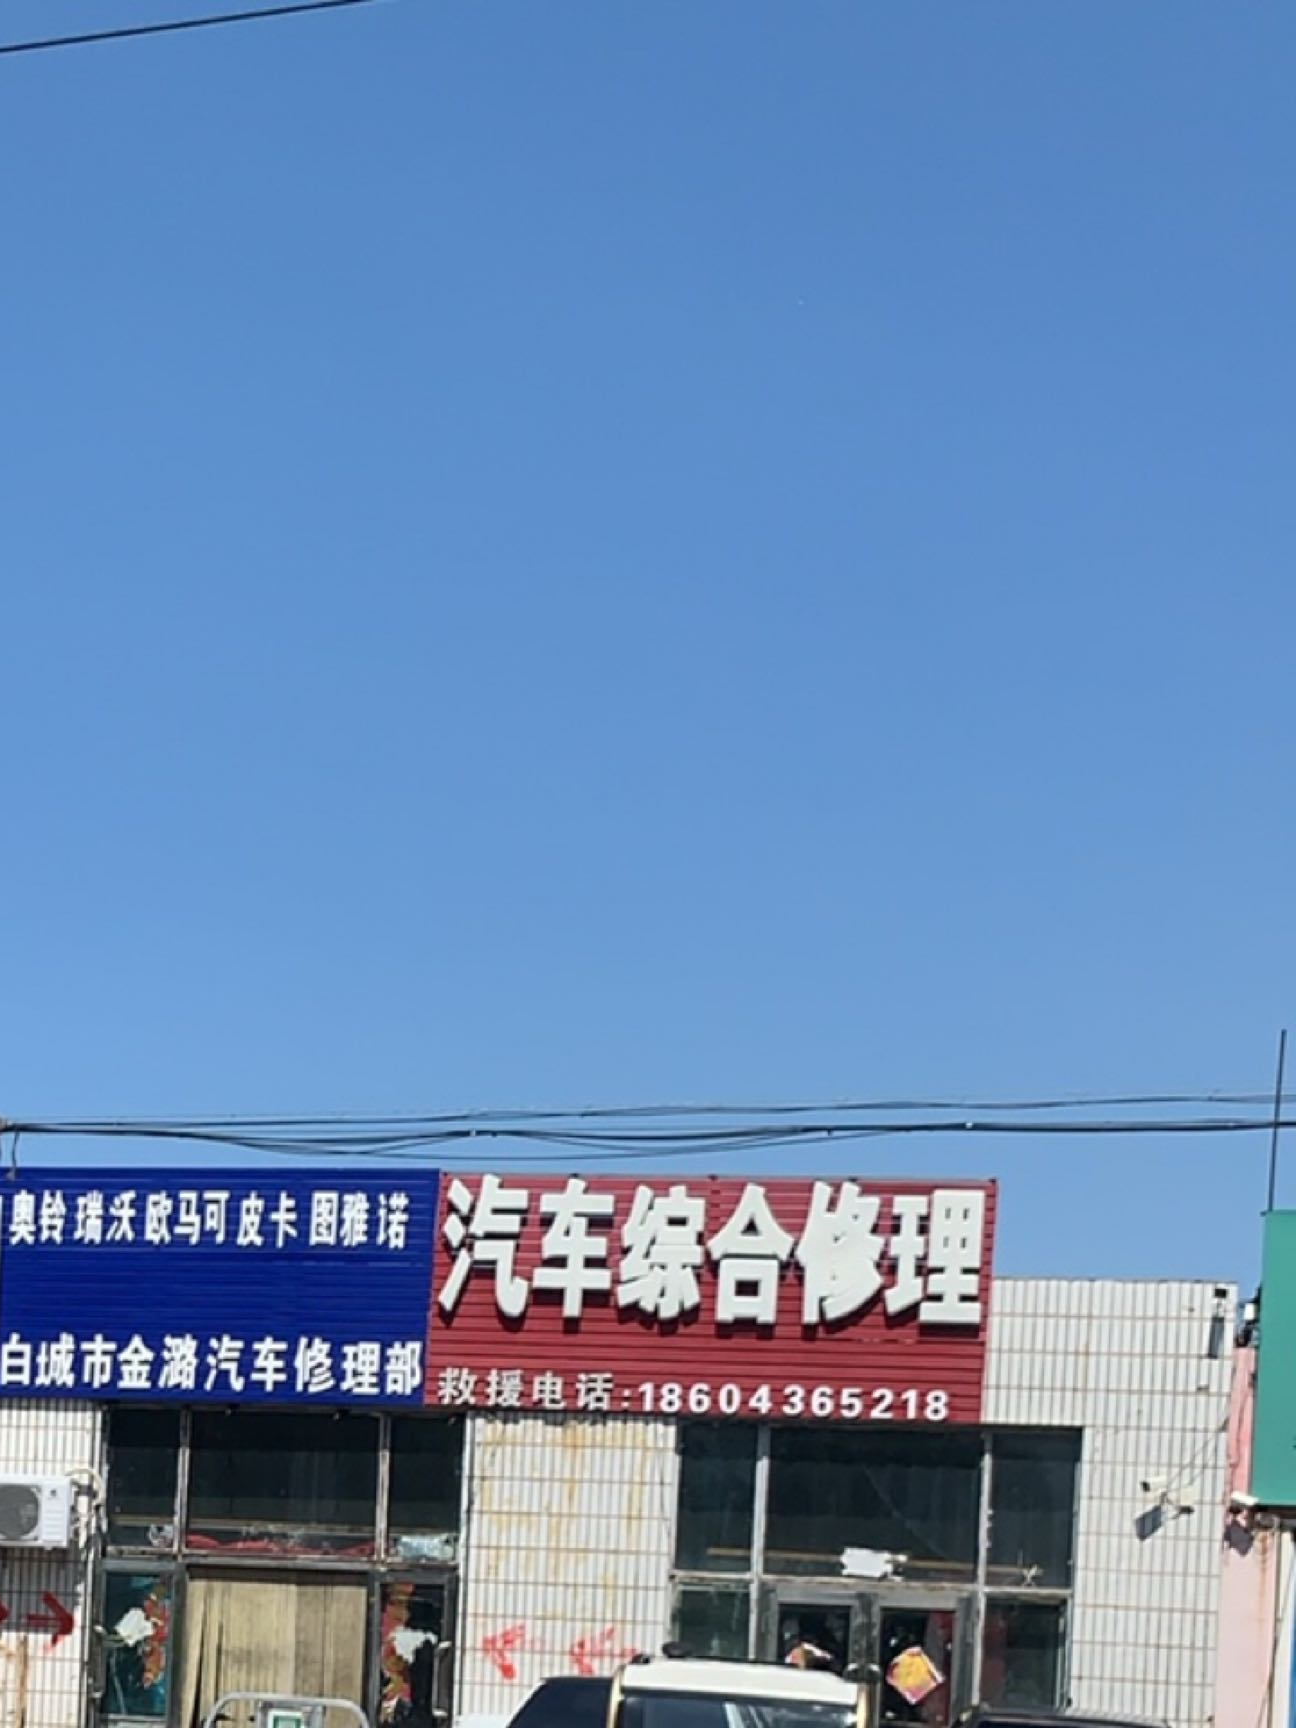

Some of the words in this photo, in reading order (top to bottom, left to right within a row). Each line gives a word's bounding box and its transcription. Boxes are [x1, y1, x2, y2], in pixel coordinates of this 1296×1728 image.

[438, 1174, 986, 1325] 汽车综合修理
[0, 1333, 422, 1396] 白城市金潞汽车修理部
[438, 1367, 951, 1422] 救援电话:18604365218
